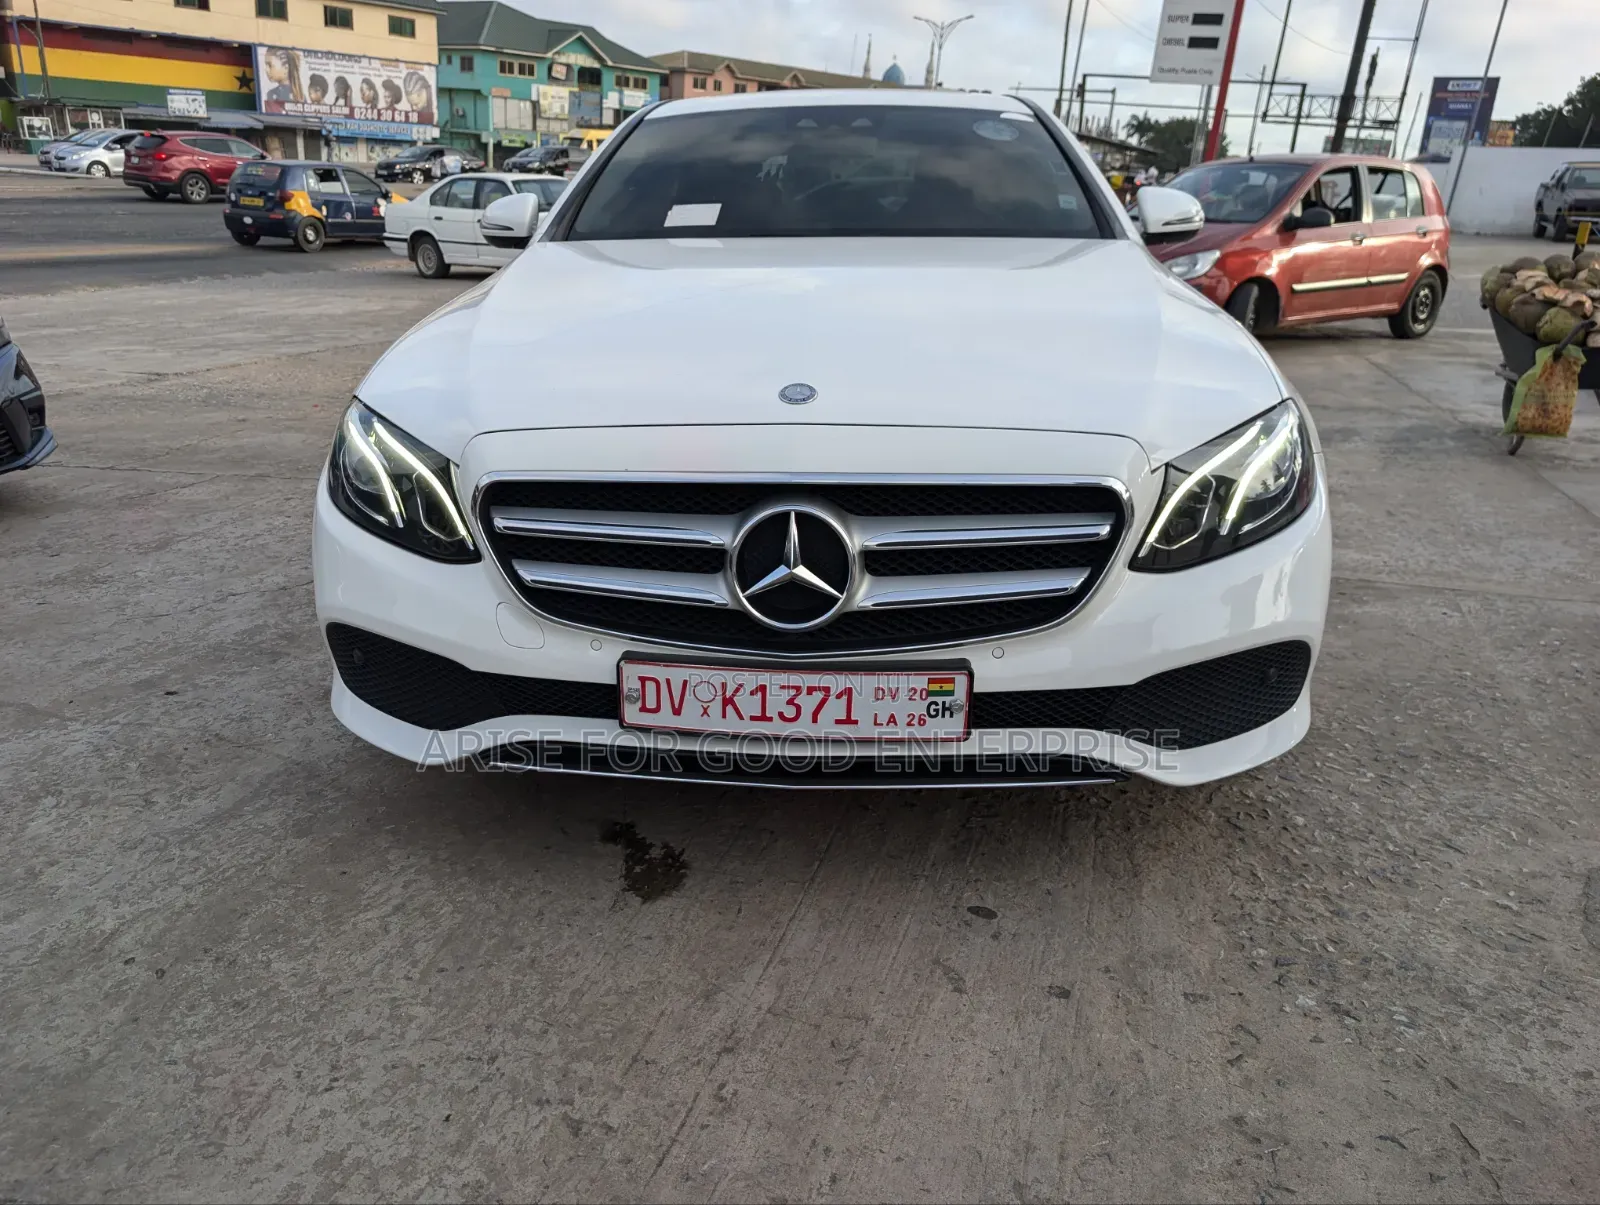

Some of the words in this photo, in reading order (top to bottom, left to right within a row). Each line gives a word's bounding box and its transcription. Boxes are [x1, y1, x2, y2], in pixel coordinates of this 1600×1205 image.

[354, 107, 378, 120] 0244
[637, 675, 689, 717] DV
[721, 681, 859, 726] K1371
[873, 686, 900, 701] DV
[908, 687, 929, 702] 20
[926, 700, 955, 719] GH
[873, 712, 898, 727] LA
[906, 712, 927, 727] 26
